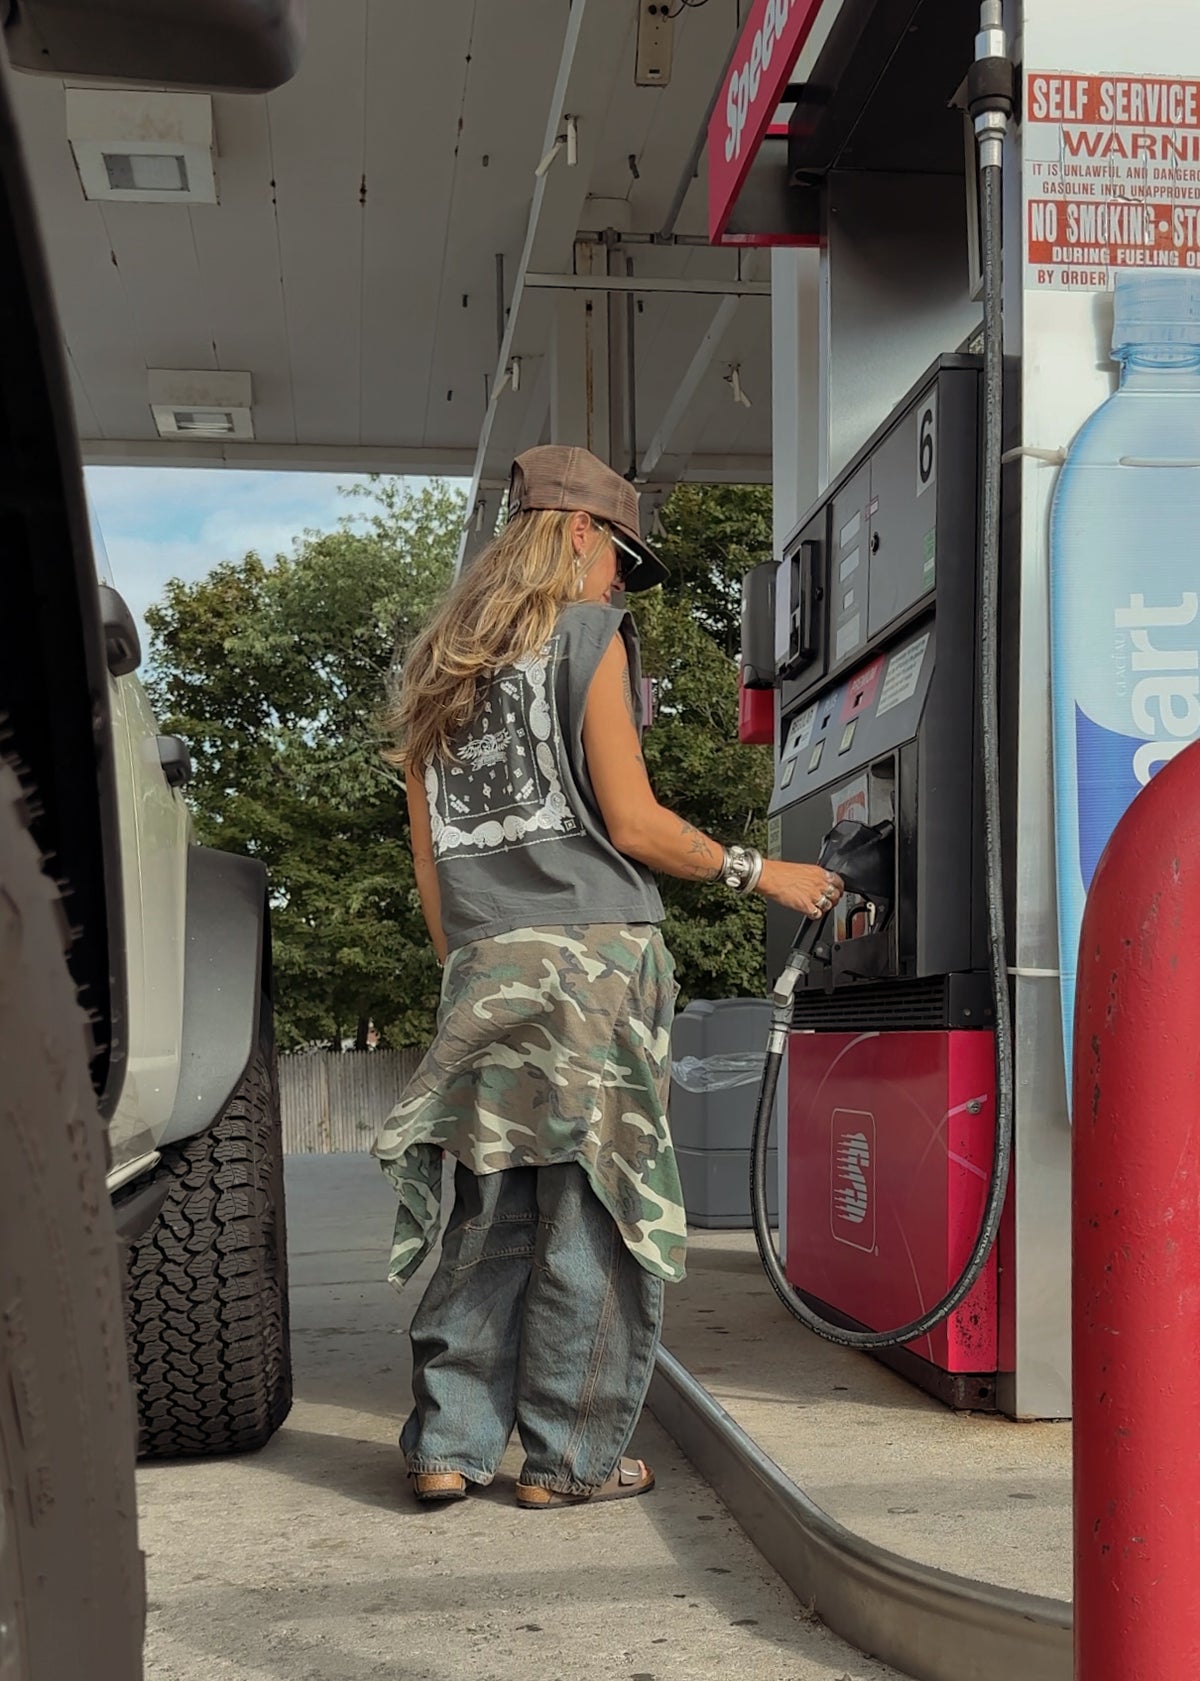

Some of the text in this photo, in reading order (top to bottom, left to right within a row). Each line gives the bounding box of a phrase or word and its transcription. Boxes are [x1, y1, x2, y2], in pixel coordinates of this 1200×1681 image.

[1032, 78, 1198, 125] SELF SERVICE
[1063, 130, 1200, 162] WARNI
[1032, 163, 1043, 176] IT
[1047, 163, 1058, 177] IS
[1063, 164, 1121, 179] UNLAWFUL
[1126, 167, 1148, 180] AND
[1042, 181, 1200, 200] GASOLINE INTO UNAPPROVED
[1031, 202, 1058, 242] NO
[1066, 203, 1156, 246] SMOKING
[1052, 247, 1110, 265] DURING
[1116, 248, 1179, 267] FUELING
[1037, 269, 1106, 286] BY ORDER
[919, 408, 933, 484] 6
